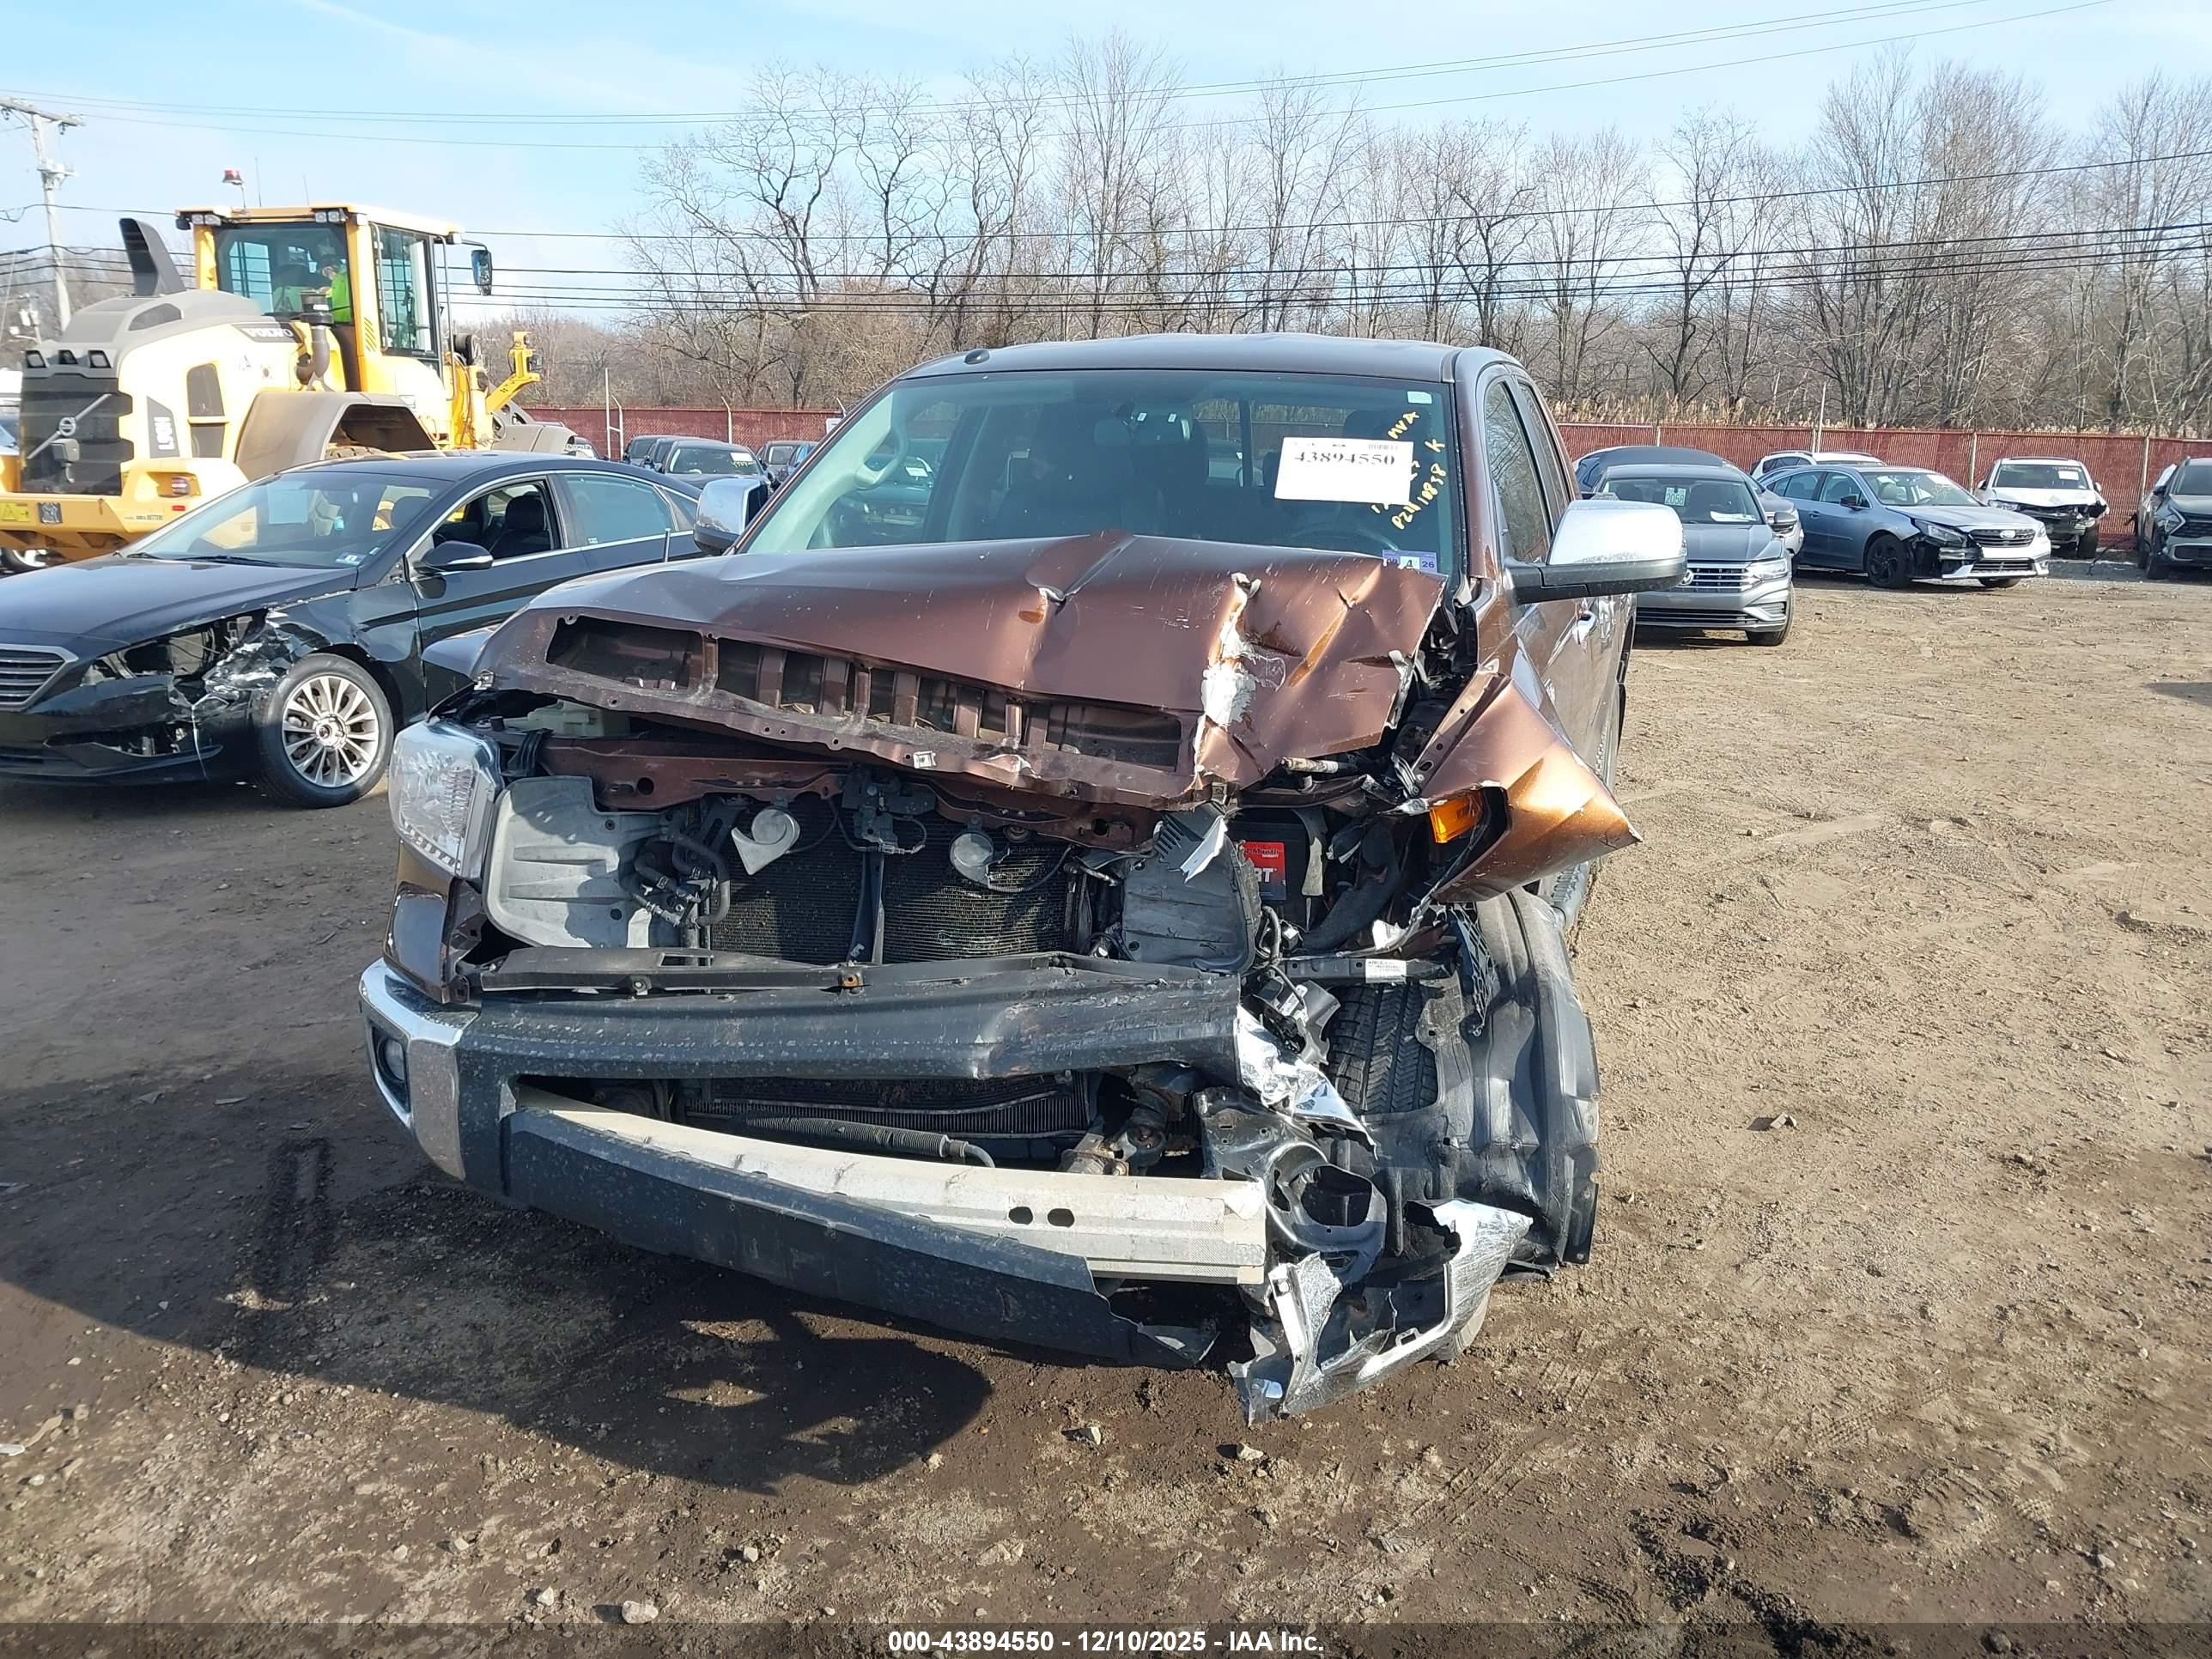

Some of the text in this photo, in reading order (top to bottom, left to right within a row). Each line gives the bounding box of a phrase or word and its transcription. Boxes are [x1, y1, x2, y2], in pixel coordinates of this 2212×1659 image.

[1424, 438, 1445, 453] K
[1294, 451, 1395, 465] 43894550
[1666, 493, 1684, 505] 2058
[1421, 560, 1435, 568] 26
